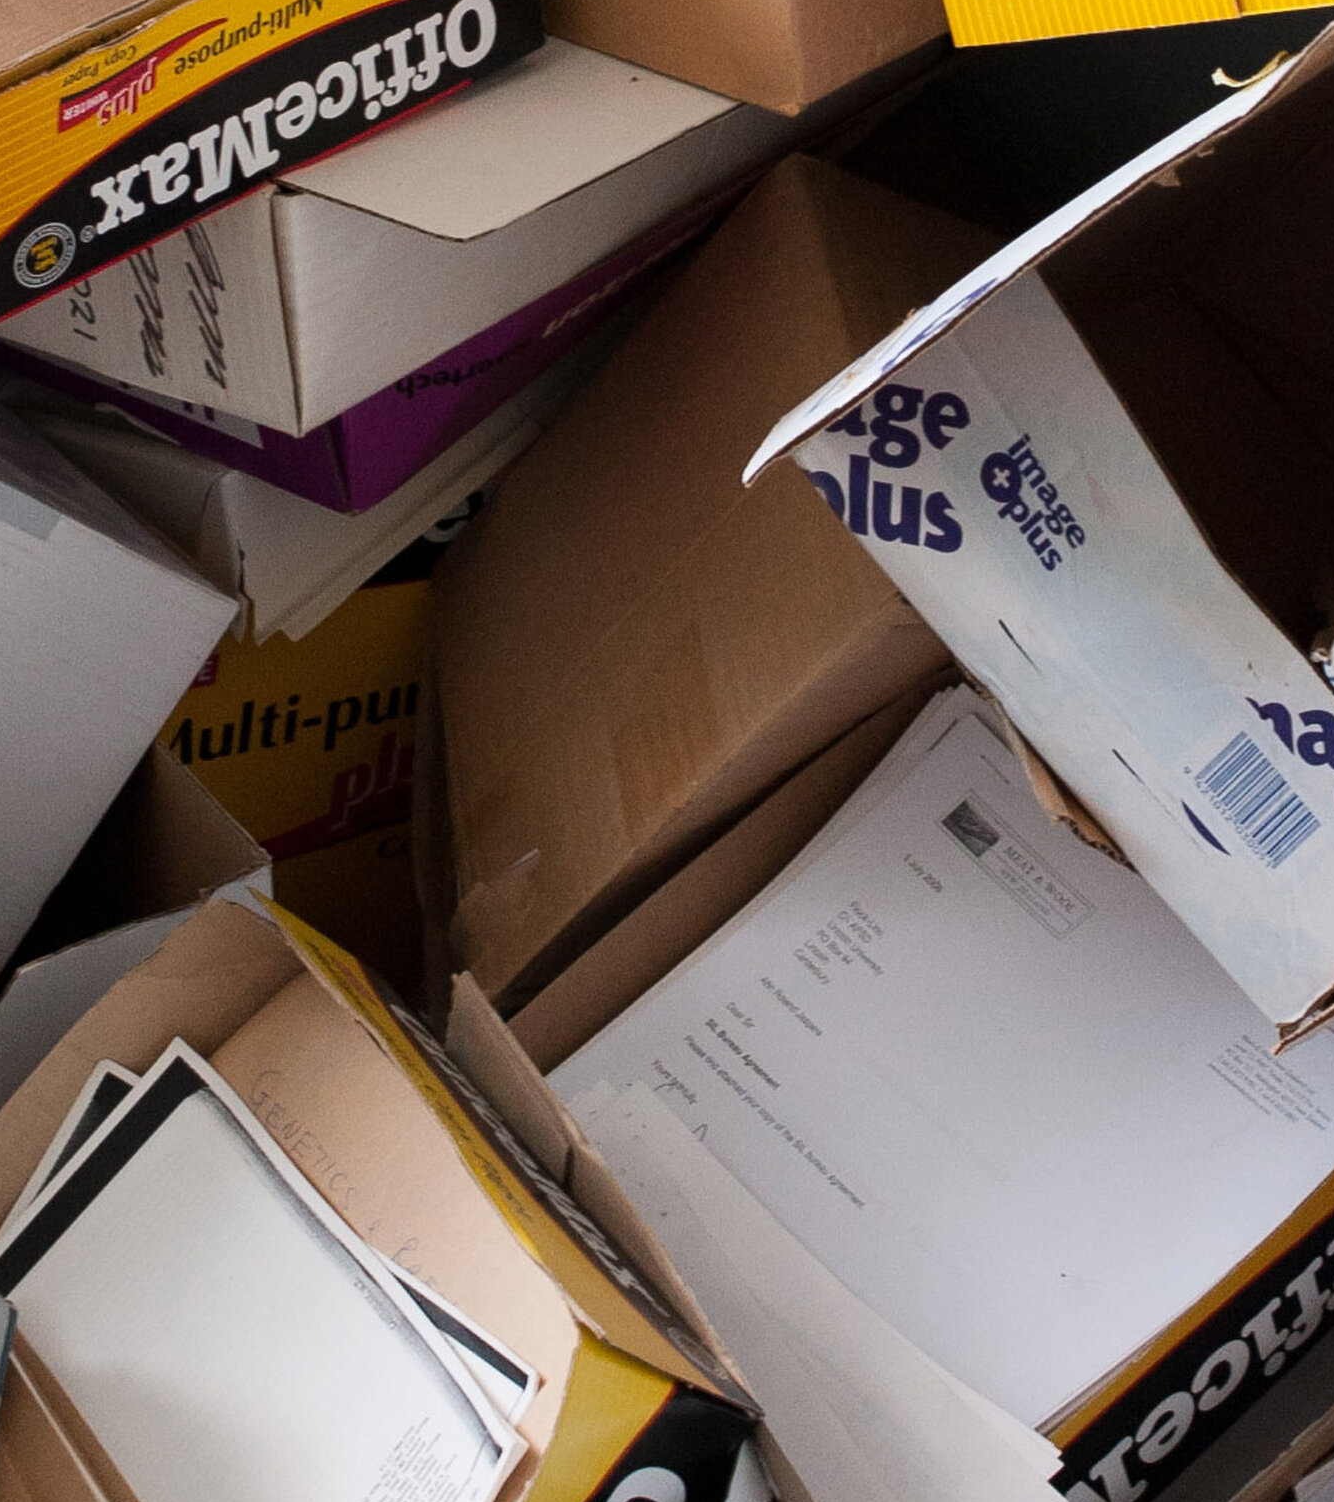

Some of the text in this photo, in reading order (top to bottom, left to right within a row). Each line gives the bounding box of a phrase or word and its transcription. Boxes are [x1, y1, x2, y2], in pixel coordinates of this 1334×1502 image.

[62, 45, 137, 87] Copy Paper
[98, 56, 158, 127] plus
[63, 90, 109, 122] WHITER
[1006, 434, 1087, 549] image
[1003, 495, 1063, 572] plus
